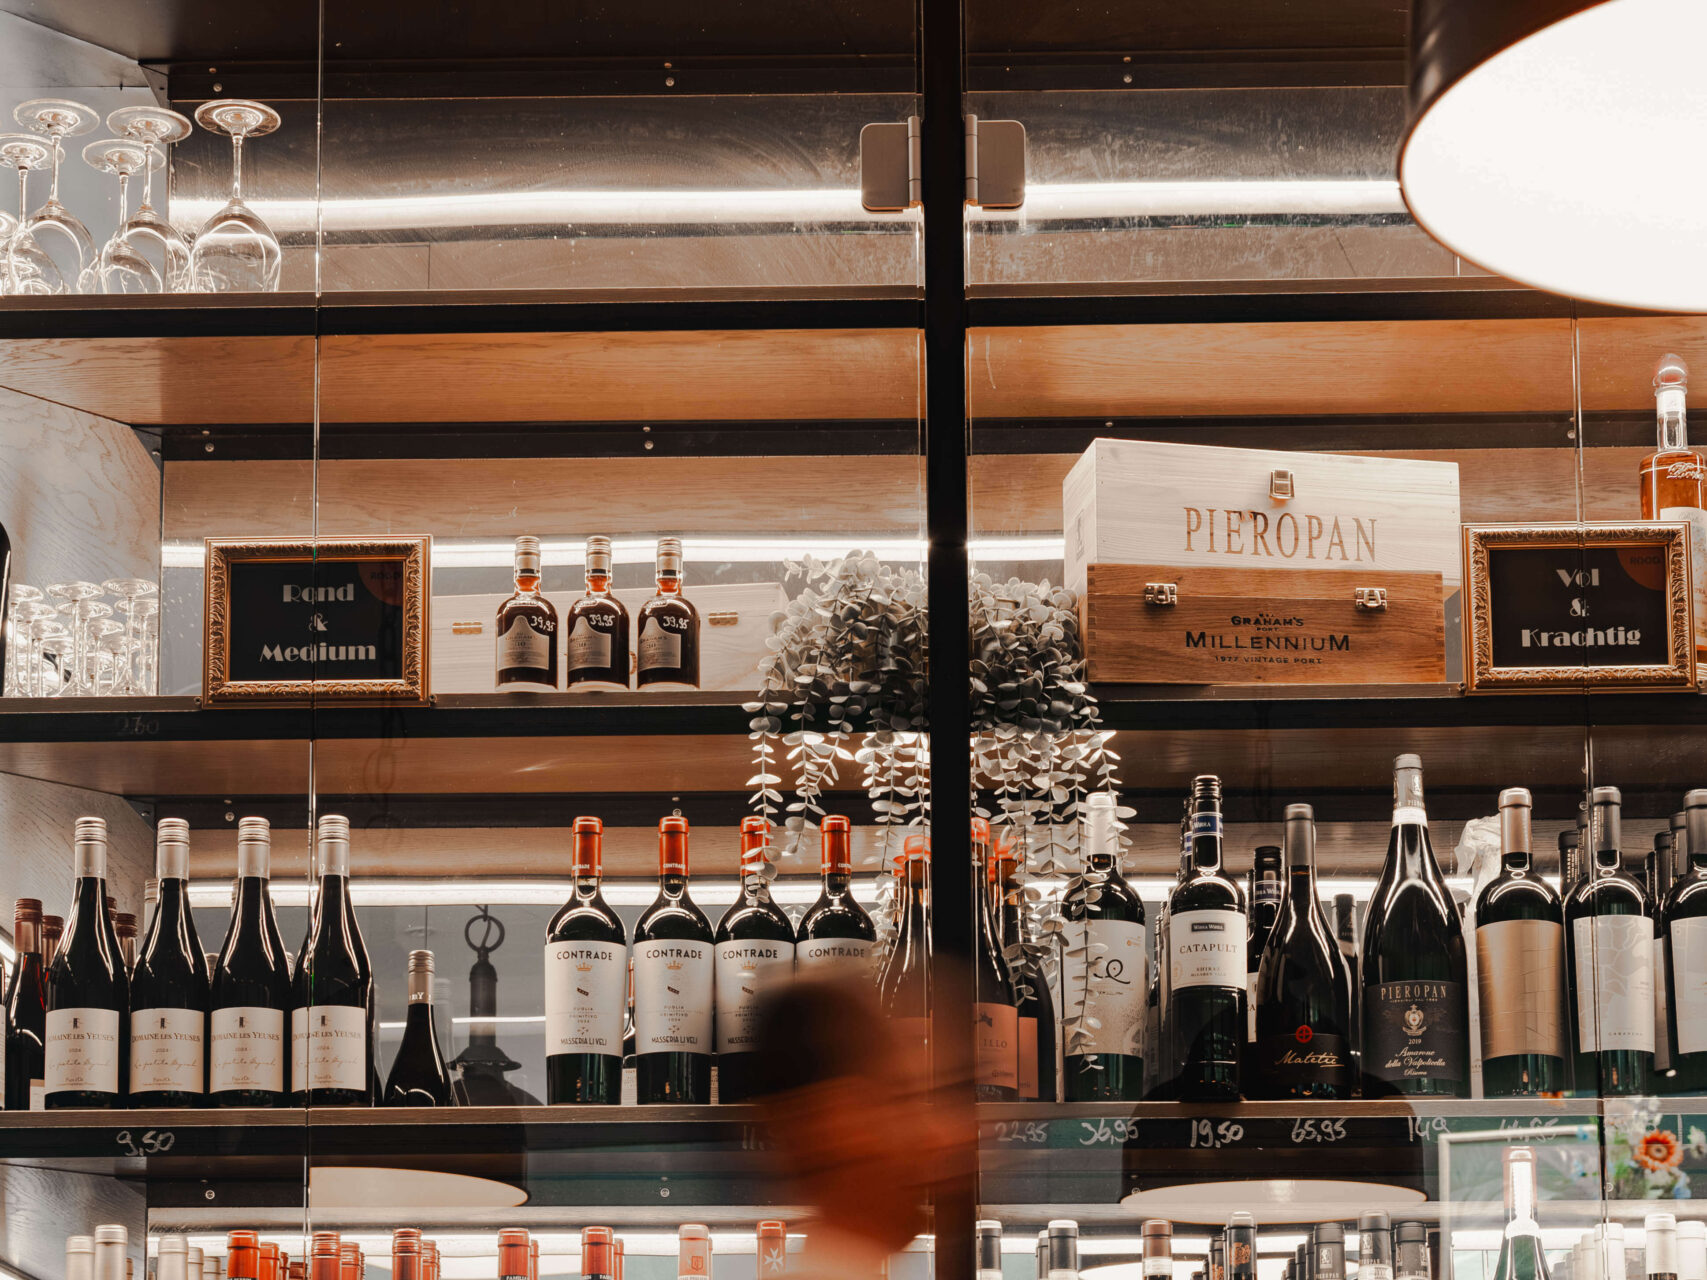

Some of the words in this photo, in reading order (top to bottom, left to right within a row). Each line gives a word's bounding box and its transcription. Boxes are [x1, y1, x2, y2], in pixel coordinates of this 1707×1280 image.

[1184, 507, 1378, 562] PIEROPAN
[1556, 568, 1600, 588] Vol
[283, 584, 355, 603] Rond
[1569, 597, 1590, 617] &
[308, 613, 329, 632] &
[1231, 615, 1305, 627] GRAHAM'S
[1185, 631, 1350, 651] MILLENNIUM
[1520, 626, 1642, 649] Krachtig
[259, 642, 377, 663] Medium
[1244, 656, 1289, 664] VINTAGE
[1294, 657, 1323, 665] PORT
[556, 950, 613, 961] CONTRADE
[646, 948, 703, 960] CONTRADE
[722, 948, 778, 960] CONTRADE
[808, 946, 865, 958] CONTRADE
[1179, 943, 1239, 955] CATAPULT
[1380, 984, 1447, 1001] PIEROPAN
[1395, 1046, 1436, 1058] Amarone
[116, 1130, 176, 1156] 9,50
